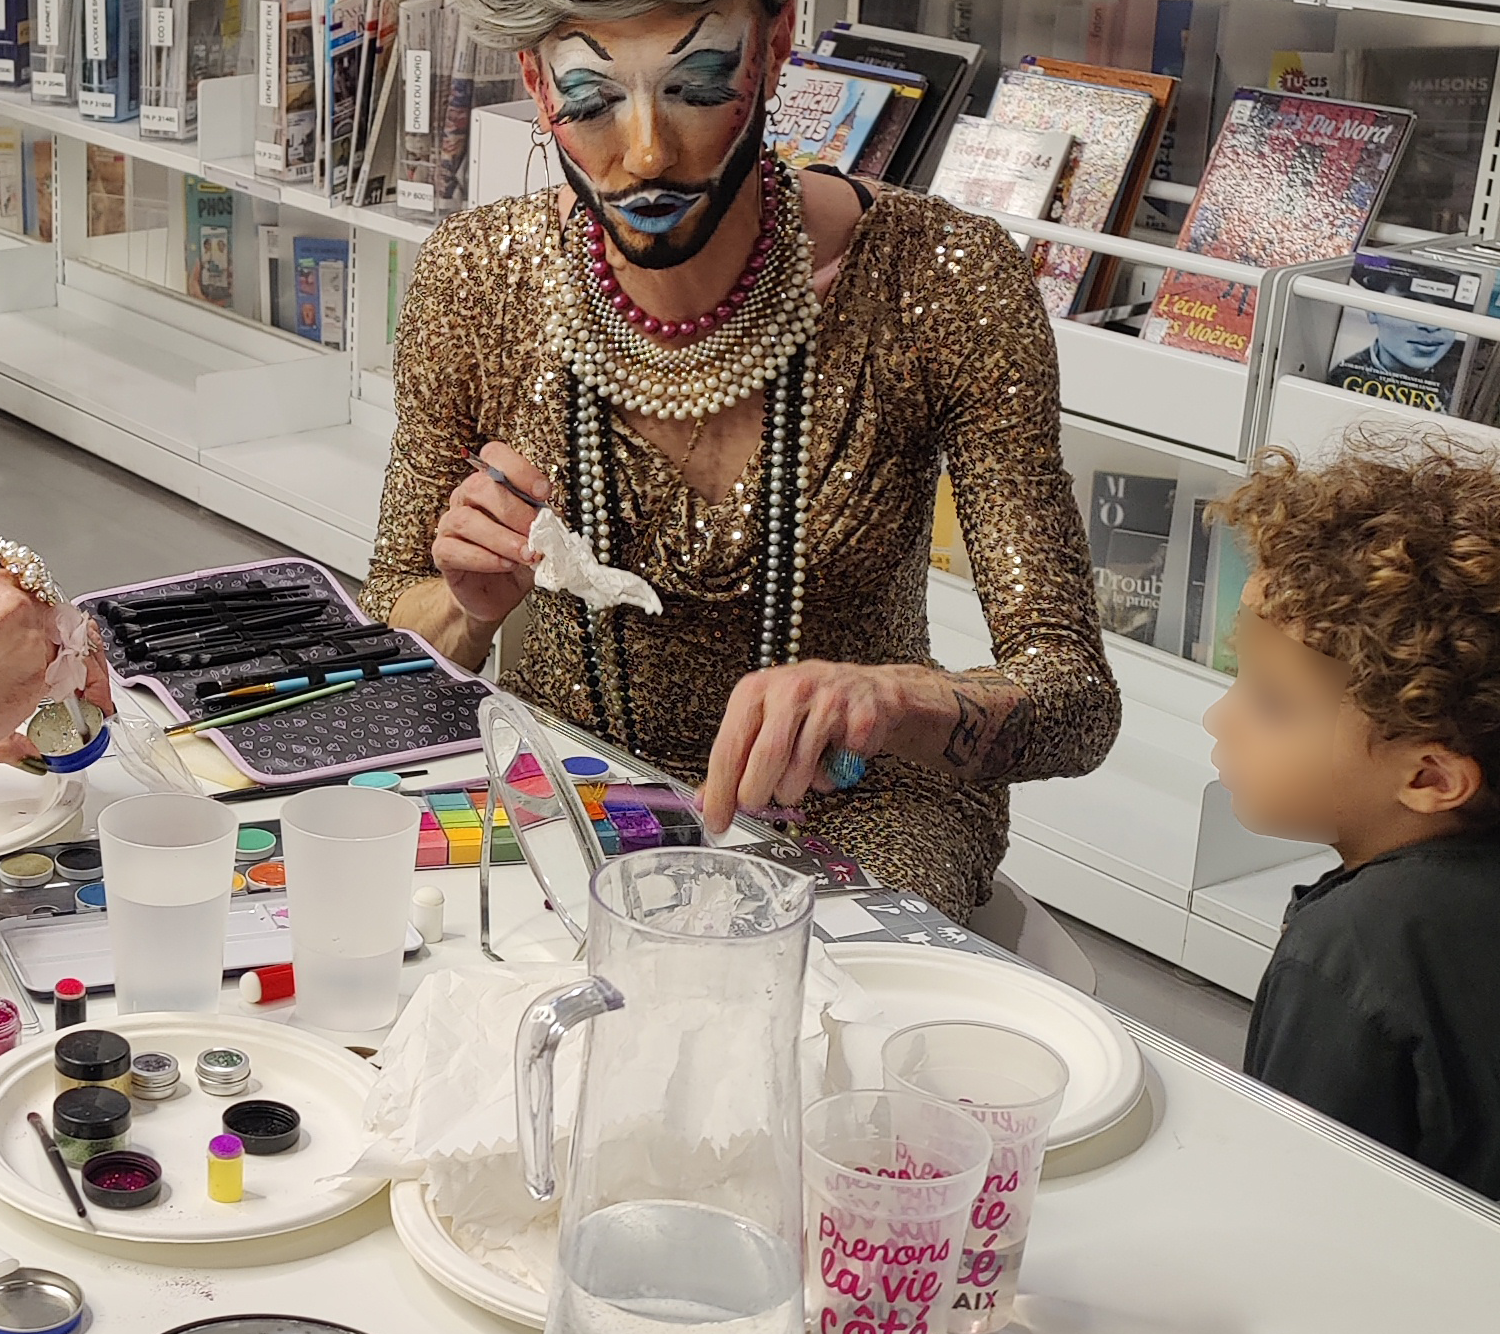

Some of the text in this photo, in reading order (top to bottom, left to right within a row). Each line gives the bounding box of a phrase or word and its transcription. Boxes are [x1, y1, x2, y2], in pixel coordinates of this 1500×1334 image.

[413, 55, 422, 130] CROIX DU NORD
[1407, 77, 1489, 92] MAISONS
[784, 90, 841, 115] CHICHI
[1308, 114, 1337, 135] Du
[1337, 119, 1393, 144] Nord
[1158, 294, 1219, 322] L'éclat
[1183, 320, 1248, 351] Moëres
[1343, 375, 1438, 413] GOSSES
[970, 1196, 1012, 1231] ie
[820, 1246, 873, 1302] la
[881, 1268, 943, 1304] vie
